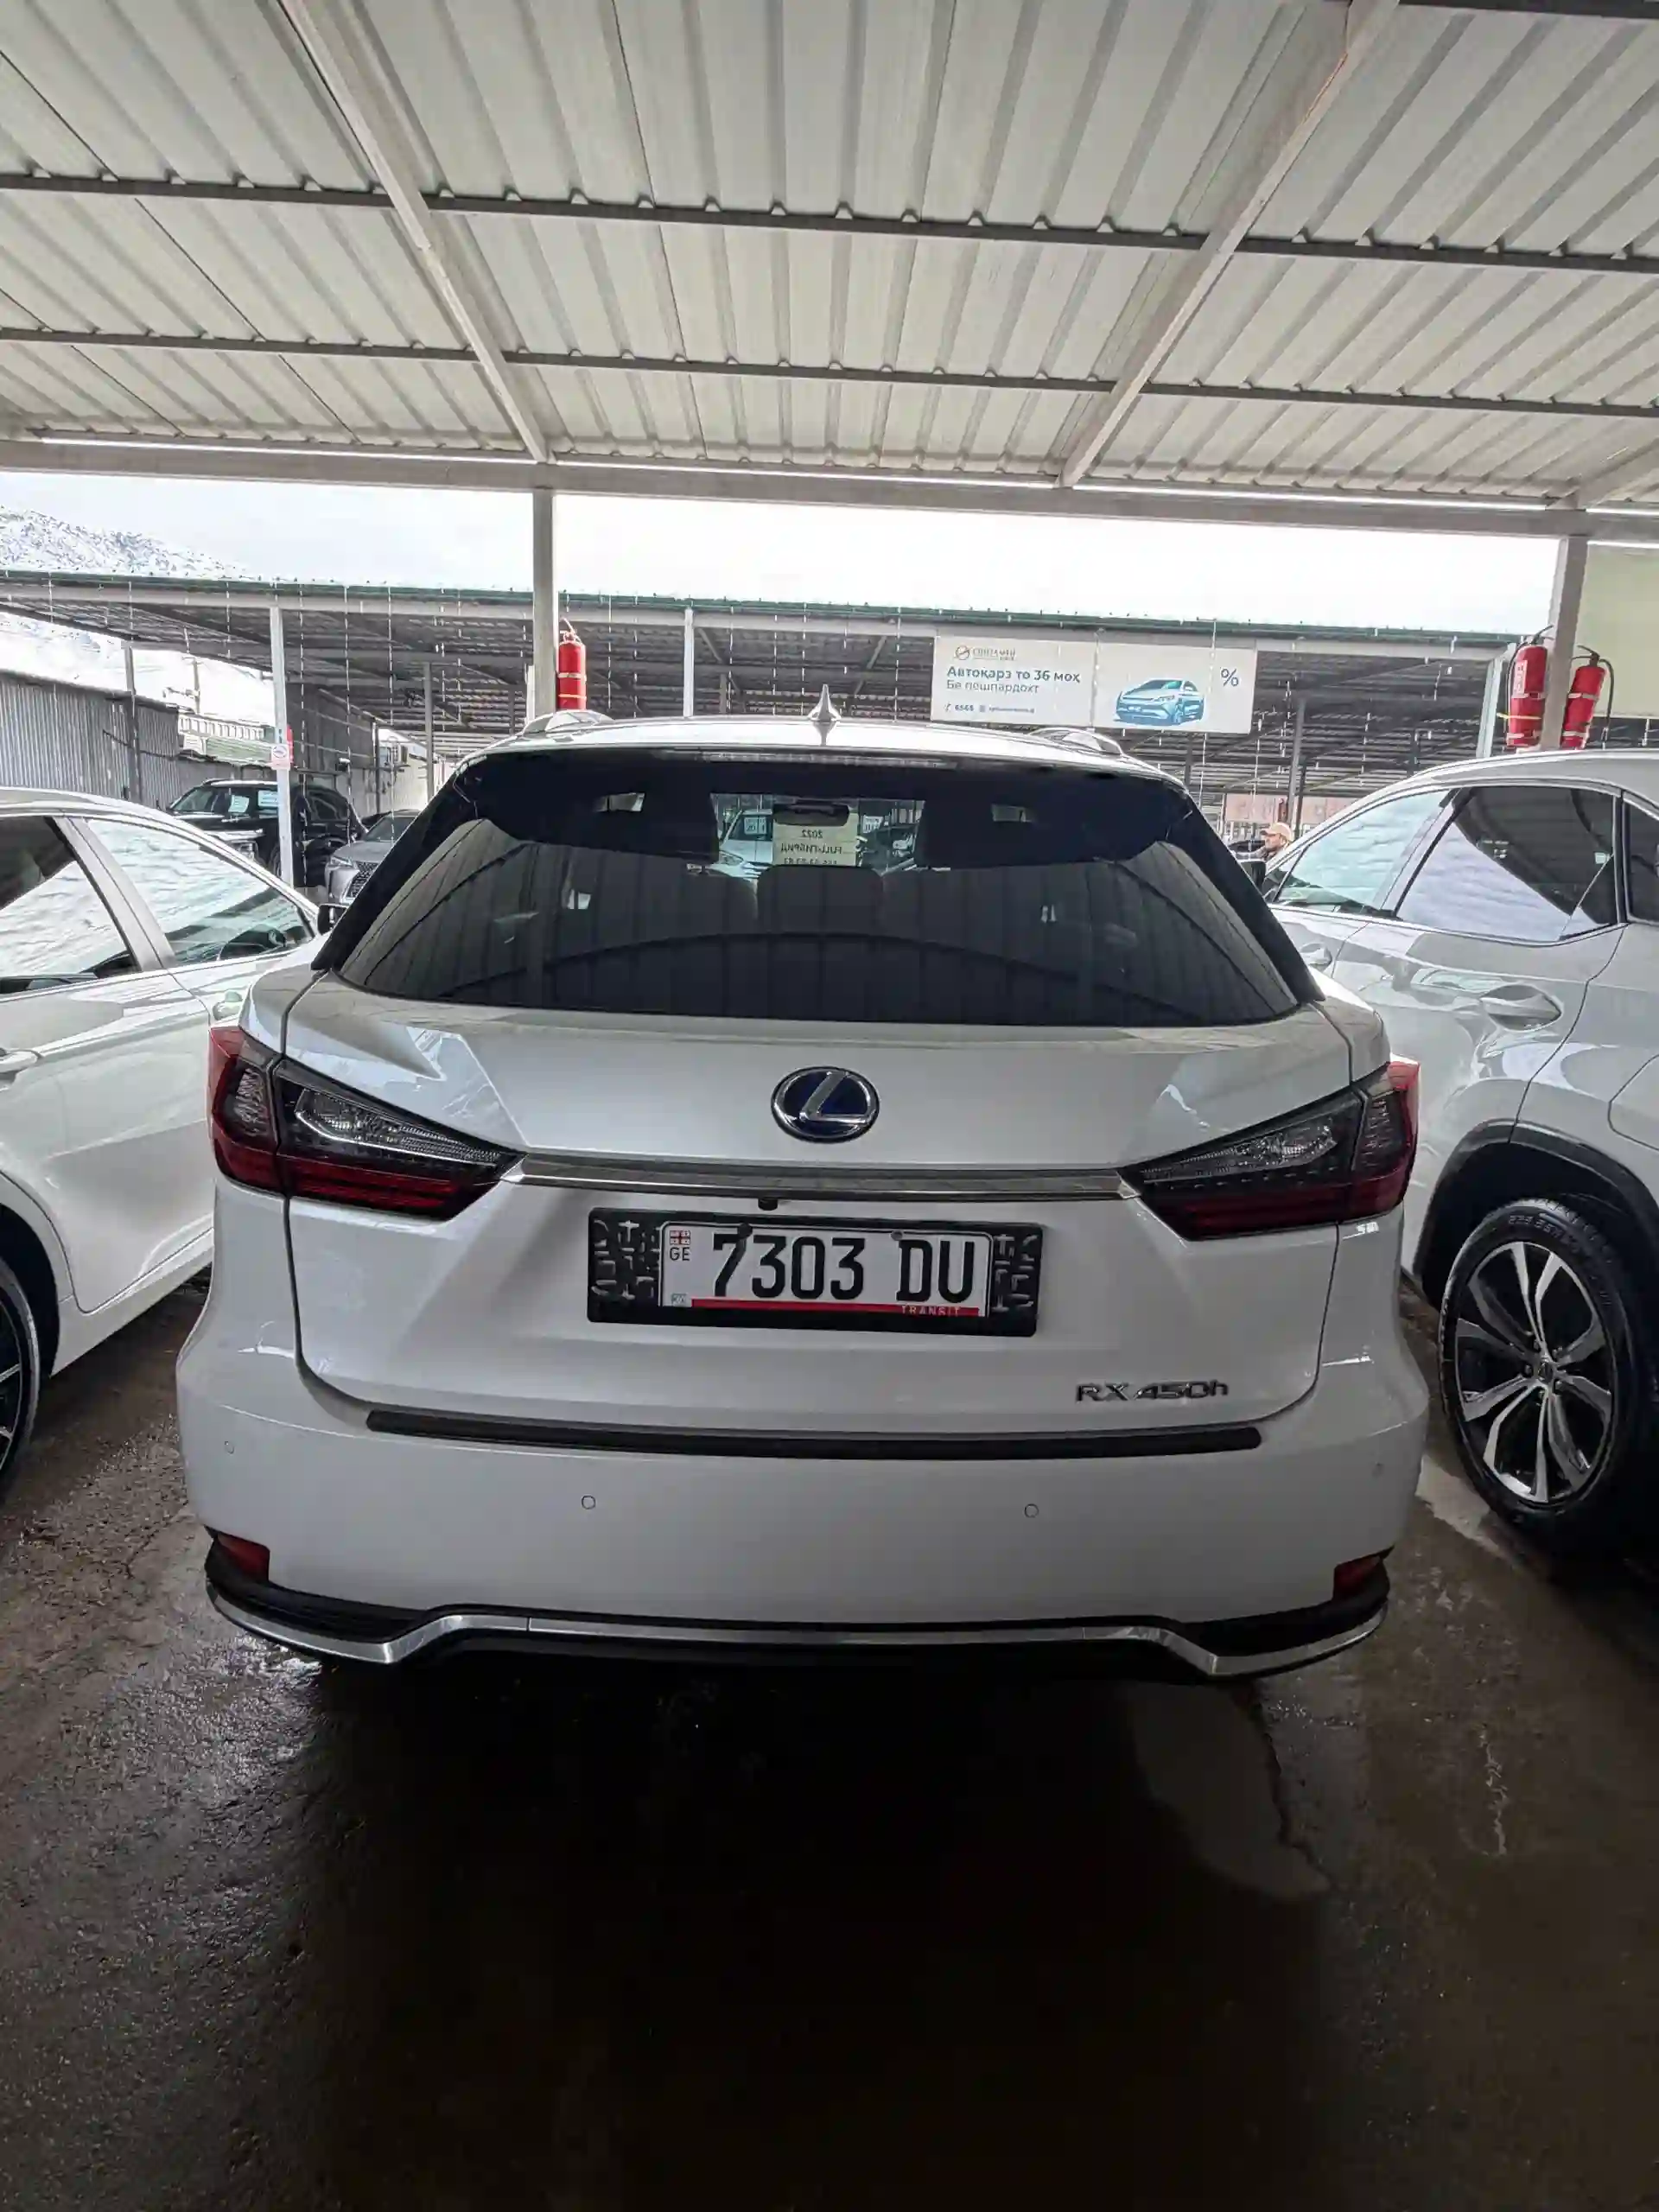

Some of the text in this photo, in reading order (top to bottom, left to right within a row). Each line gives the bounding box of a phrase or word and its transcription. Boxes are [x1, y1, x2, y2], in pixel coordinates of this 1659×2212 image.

[1016, 671, 1030, 679] то
[1033, 670, 1050, 681] 36
[670, 1247, 690, 1261] GE
[713, 1233, 975, 1303] 7303 DU
[901, 1305, 962, 1317] TRANSIT
[1076, 1380, 1229, 1402] RX 450h
